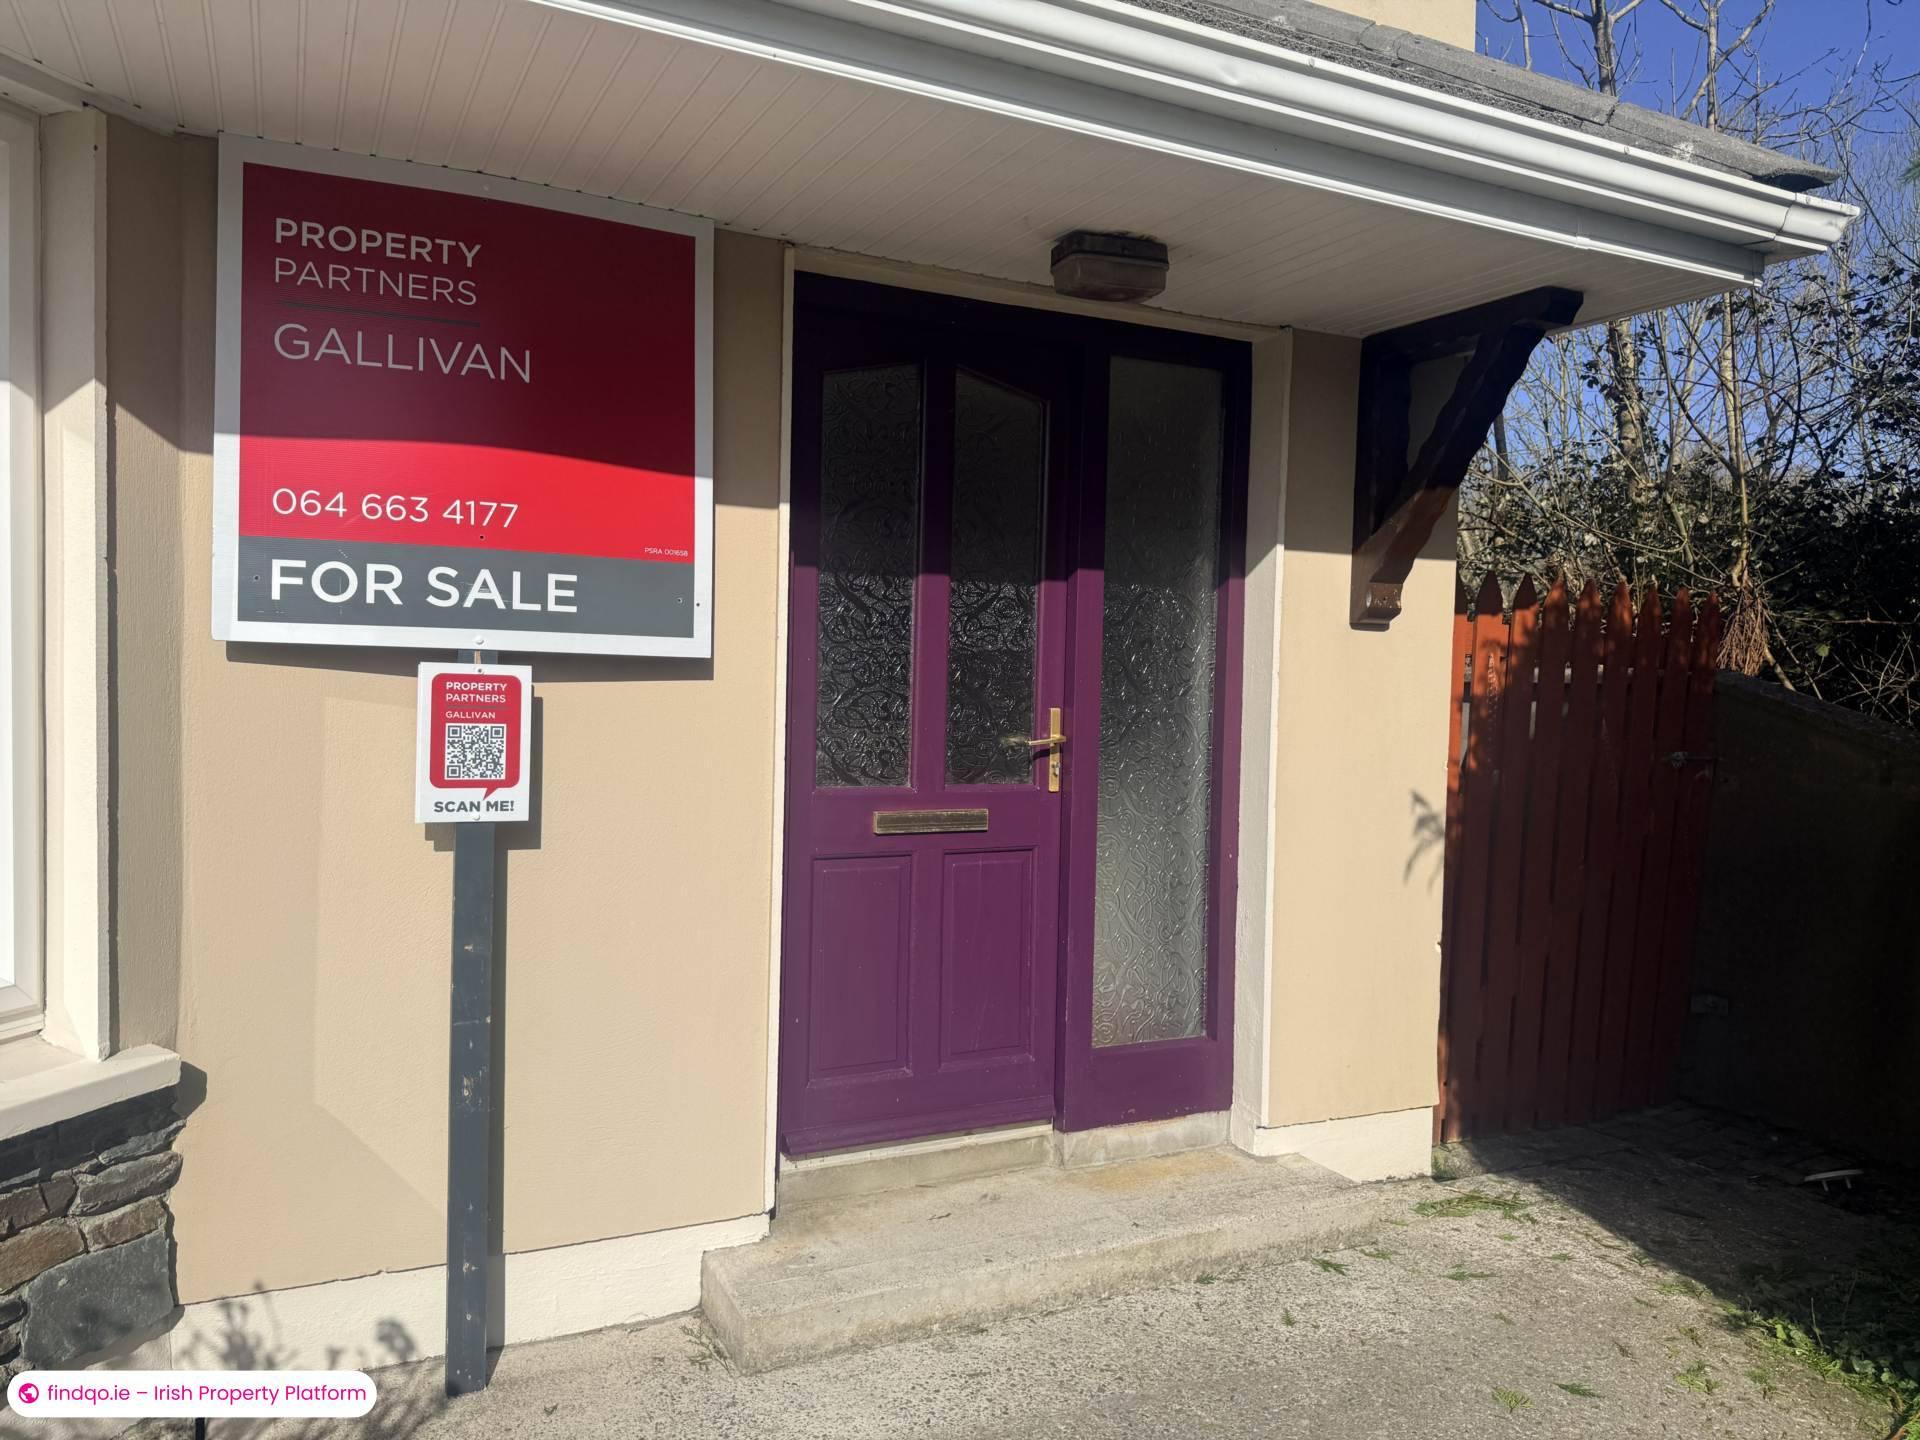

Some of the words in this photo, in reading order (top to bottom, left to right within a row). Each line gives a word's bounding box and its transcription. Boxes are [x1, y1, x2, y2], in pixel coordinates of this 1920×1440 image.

[275, 217, 482, 268] PROPERTY
[275, 257, 477, 306] PARTNERS
[274, 323, 531, 384] GALLIVAN
[272, 488, 348, 518] 064
[361, 493, 429, 522] 663
[442, 499, 519, 528] 4177
[270, 558, 404, 606] FOR
[426, 568, 579, 613] SALE
[445, 681, 508, 692] PROPERTY
[445, 693, 506, 704] PARTNERS
[445, 711, 496, 719] GALLIVAN
[434, 801, 481, 813] SCAN
[486, 800, 515, 812] ME!
